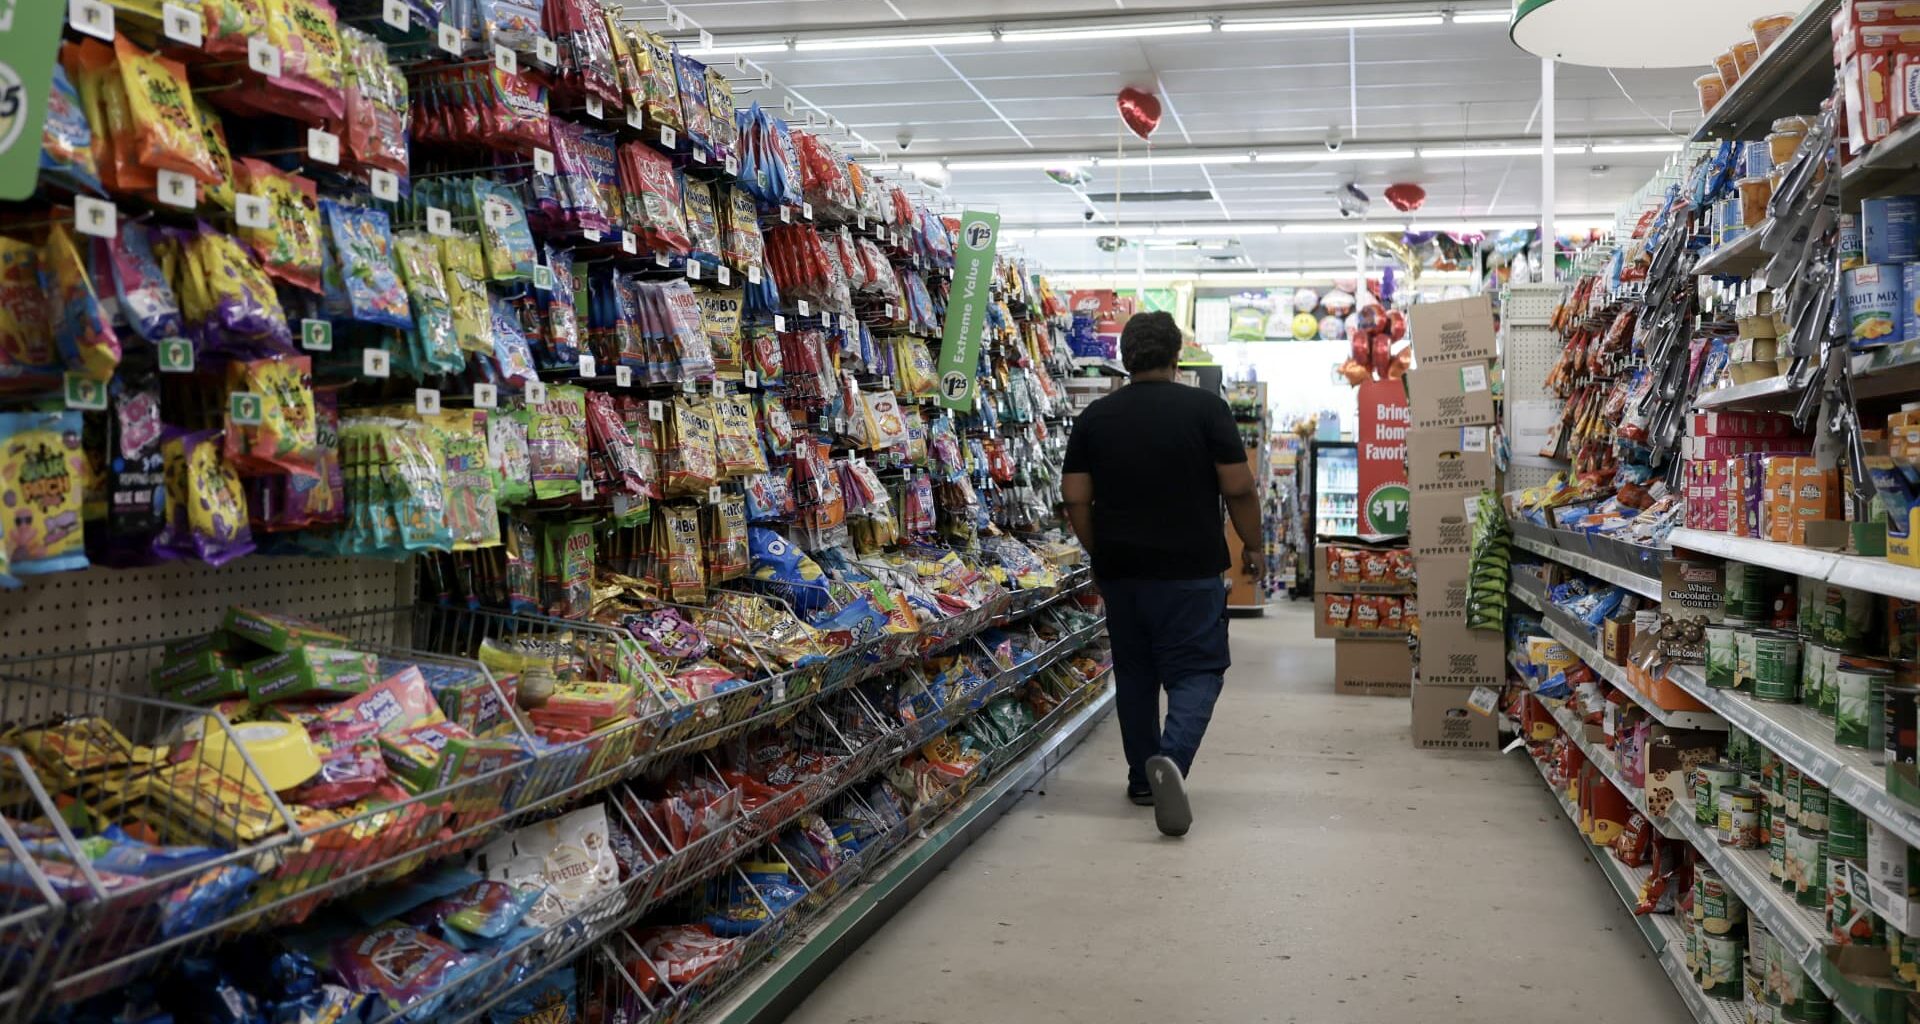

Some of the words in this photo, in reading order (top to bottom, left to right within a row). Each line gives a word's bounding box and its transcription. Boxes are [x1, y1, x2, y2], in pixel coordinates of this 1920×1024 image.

[1877, 290, 1898, 301] MIX
[953, 303, 972, 364] Extreme
[963, 257, 980, 299] Value
[1422, 353, 1457, 363] POTATO
[1461, 348, 1488, 358] CHIPS
[1377, 403, 1410, 423] Bring
[1420, 418, 1455, 428] POTATO
[1459, 414, 1487, 423] CHIPS
[1419, 480, 1454, 490] POTATO
[1458, 480, 1486, 488] CHIPS
[1372, 499, 1409, 522] $17
[568, 533, 591, 551] RIBO
[1419, 547, 1455, 555] POTATO
[1687, 583, 1713, 593] White
[1669, 590, 1710, 601] Chocolate
[1681, 601, 1719, 609] COOKIES
[1426, 610, 1462, 618] POTATO
[1429, 676, 1465, 684] POTATO
[1469, 676, 1497, 684] CHIPS
[1423, 740, 1459, 748] POTATO
[1462, 740, 1490, 748] CHIPS
[551, 861, 590, 884] PRETZELS
